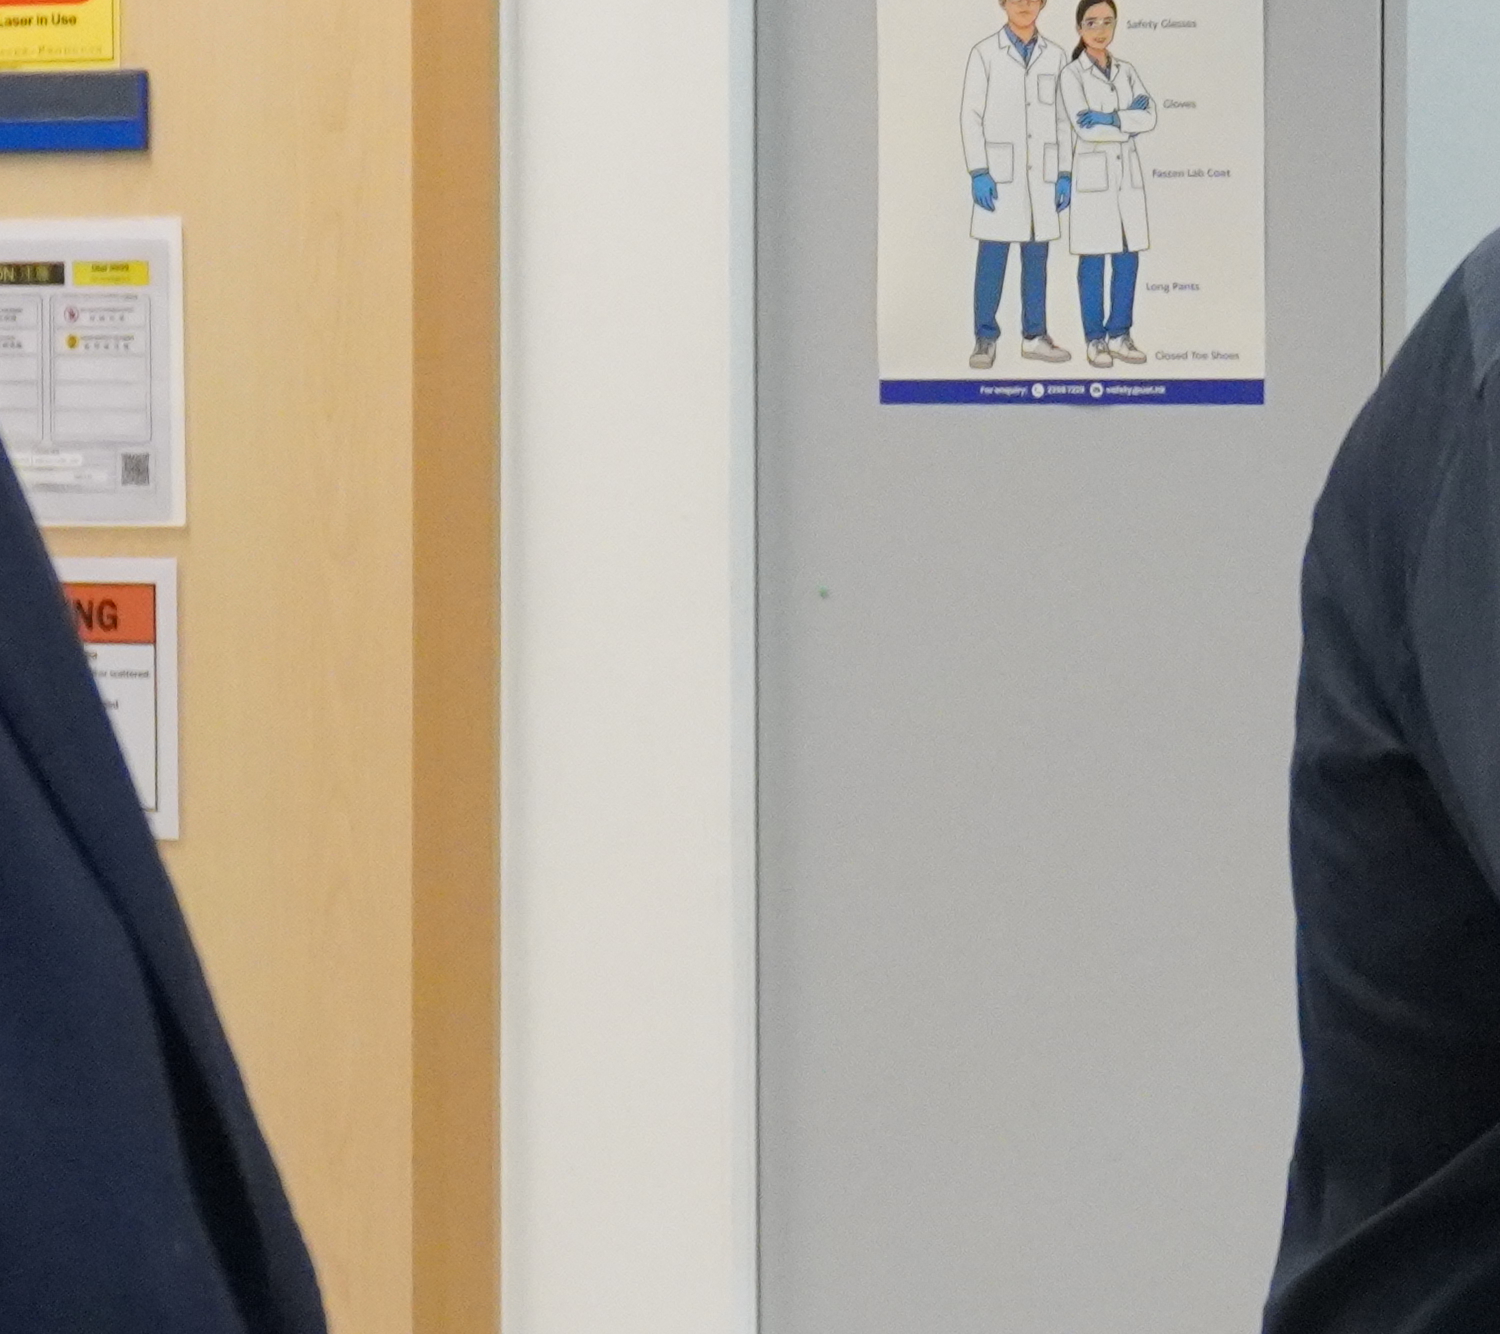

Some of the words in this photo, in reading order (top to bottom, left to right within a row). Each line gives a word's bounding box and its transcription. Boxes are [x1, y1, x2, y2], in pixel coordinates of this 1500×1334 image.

[36, 15, 47, 25] in
[51, 13, 78, 25] Use
[1127, 19, 1158, 30] Safety
[1161, 19, 1197, 28] Glasses
[1163, 99, 1196, 109] Gloves
[1187, 169, 1205, 178] Lab
[1207, 169, 1231, 178] Coat
[1146, 282, 1170, 294] Long
[1173, 282, 1200, 292] Pants
[1155, 350, 1188, 361] Closed
[1211, 350, 1240, 361] Shoes
